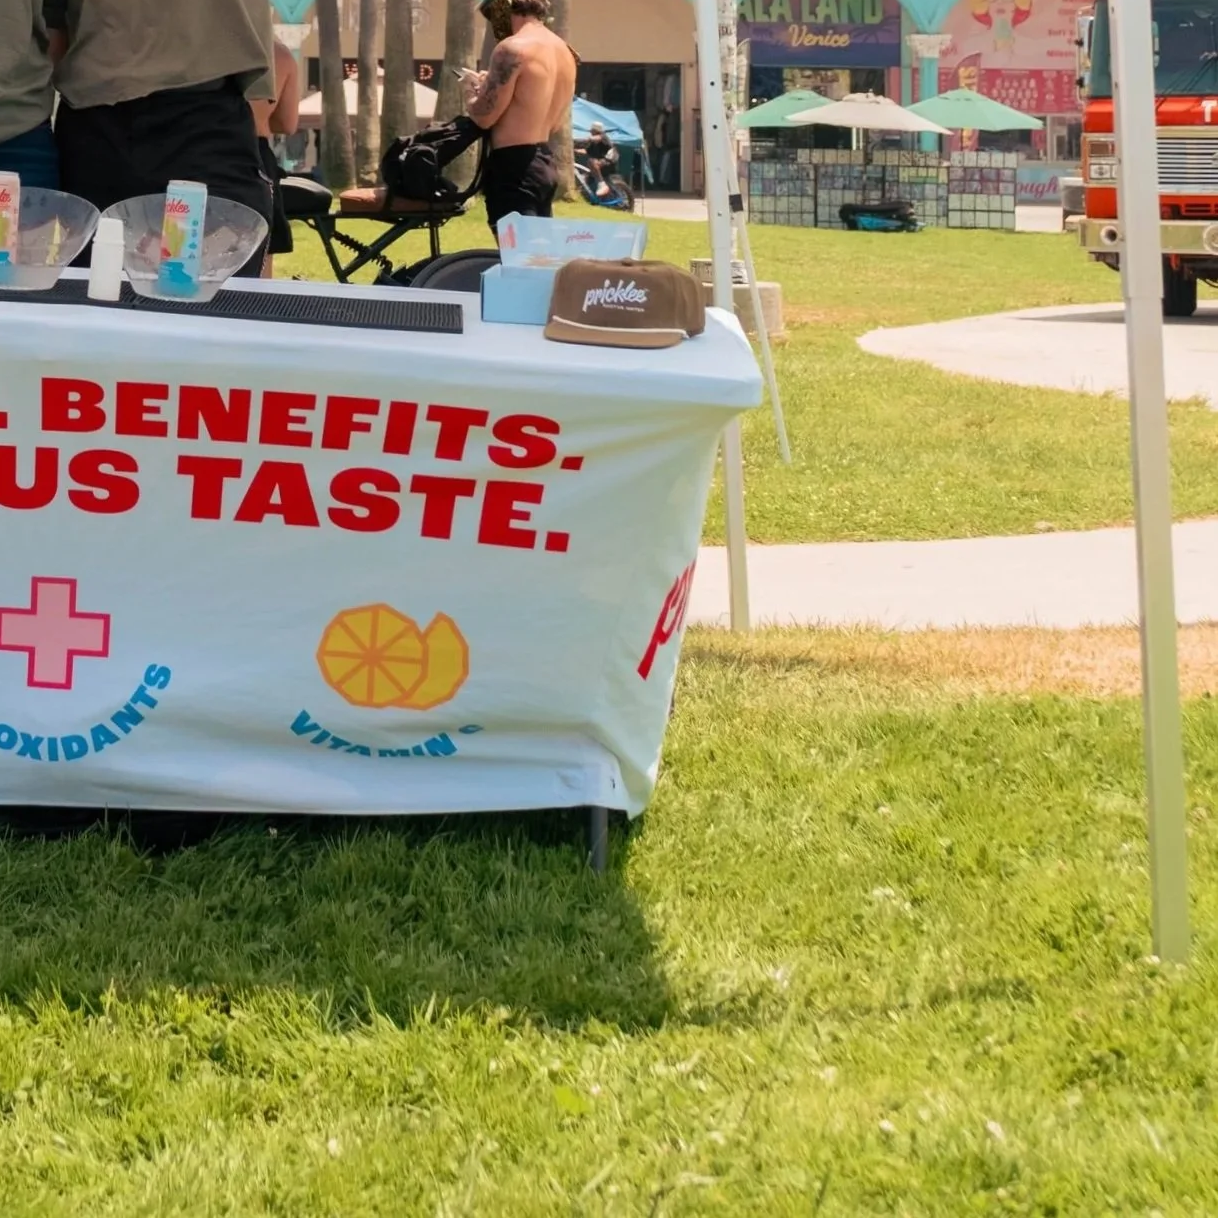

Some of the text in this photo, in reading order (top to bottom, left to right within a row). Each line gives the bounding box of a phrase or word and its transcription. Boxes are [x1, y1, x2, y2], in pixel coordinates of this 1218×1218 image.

[789, 24, 852, 48] Venice
[582, 278, 647, 313] pricklee
[41, 377, 584, 471] BENEFITS.
[177, 455, 569, 552] TASTE.
[290, 709, 458, 758] VITAMIN
